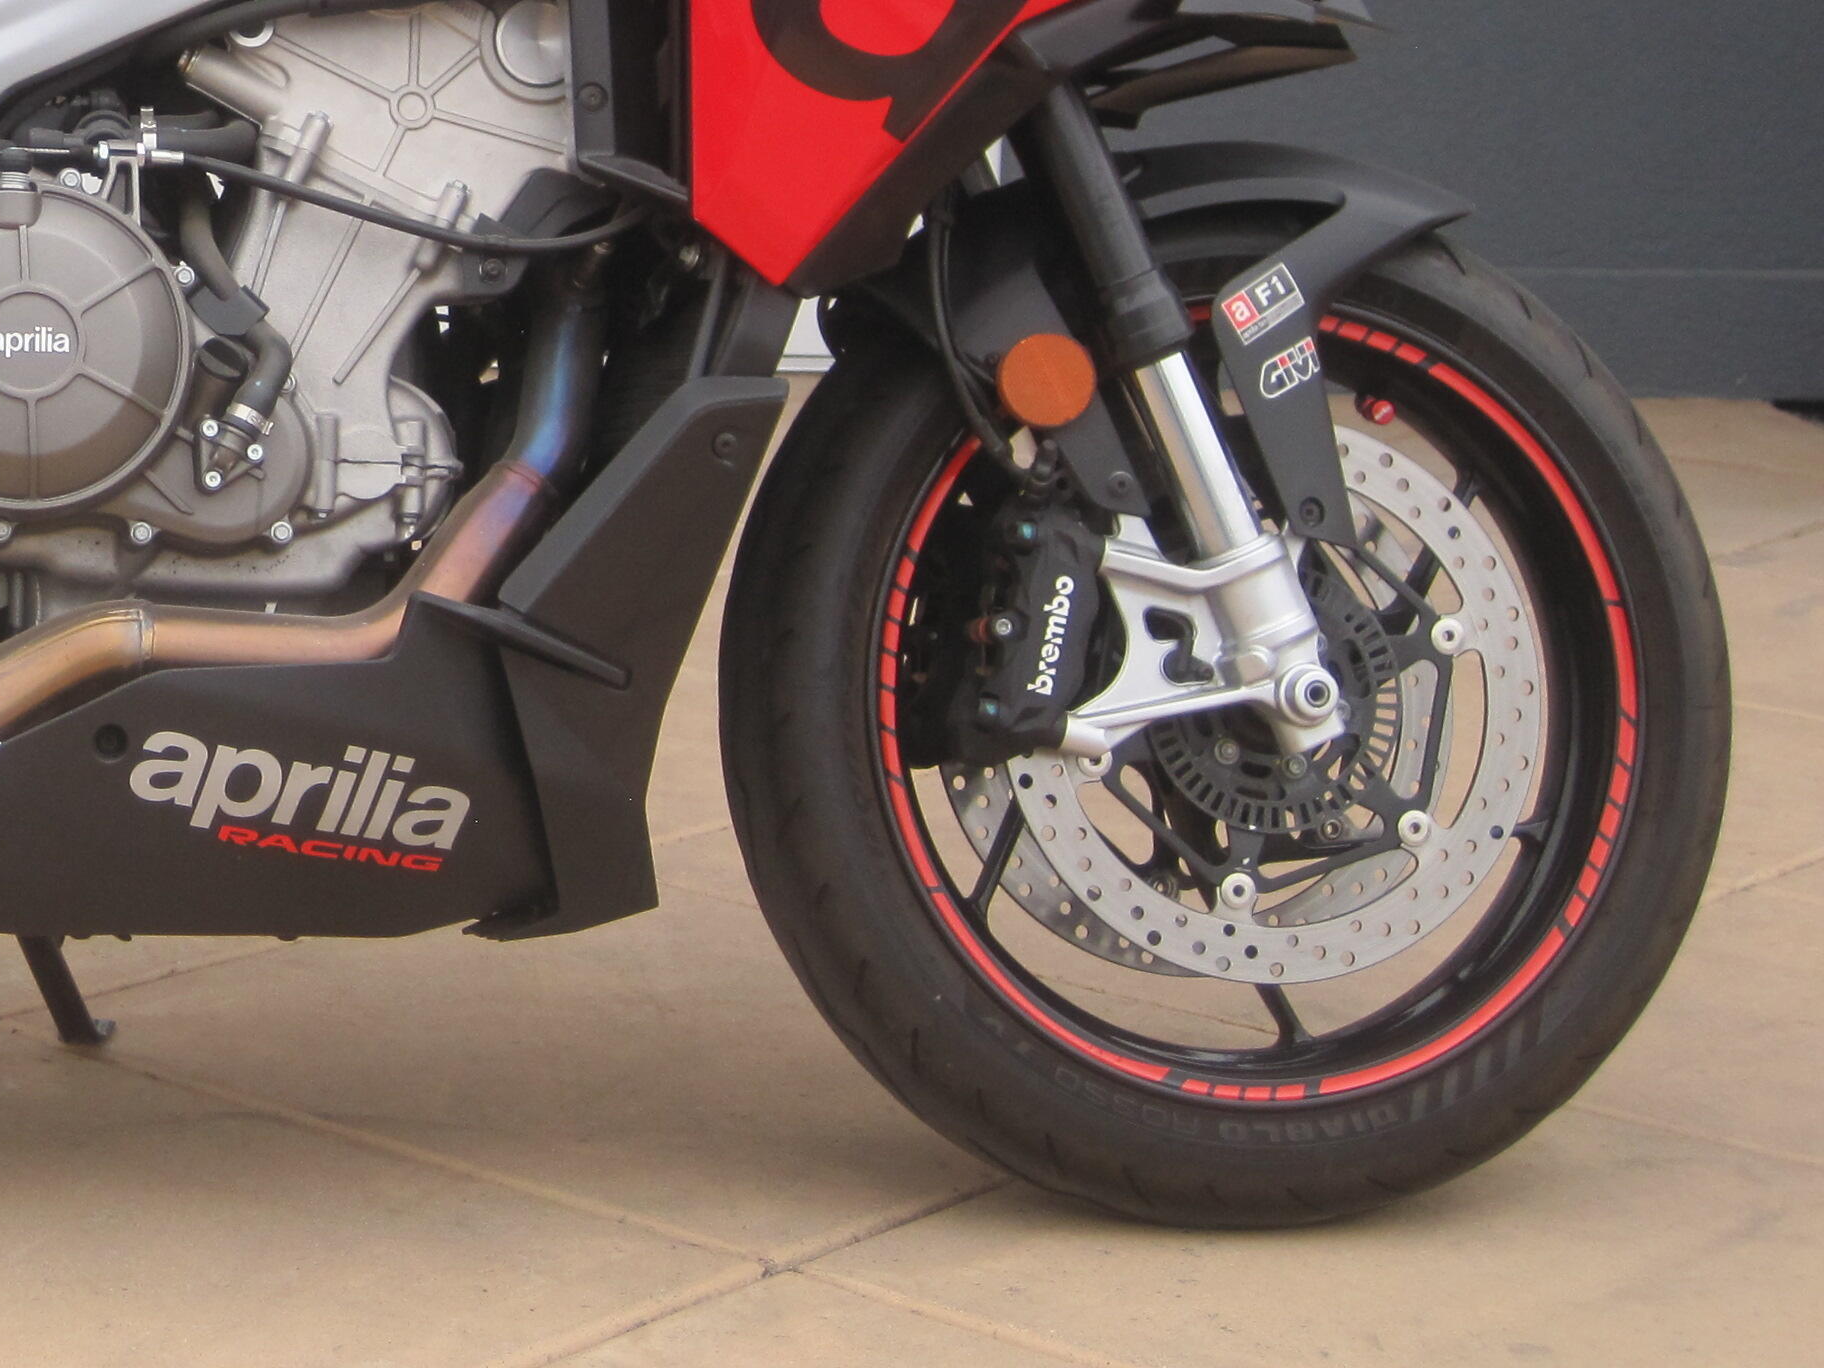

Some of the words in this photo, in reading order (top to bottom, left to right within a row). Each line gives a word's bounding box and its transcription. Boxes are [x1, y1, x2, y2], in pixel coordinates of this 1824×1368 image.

[1255, 276, 1289, 308] F1
[1260, 335, 1321, 400] GIVI
[1027, 575, 1074, 696] brembo
[129, 730, 471, 850] aprilia
[217, 825, 443, 873] RACING
